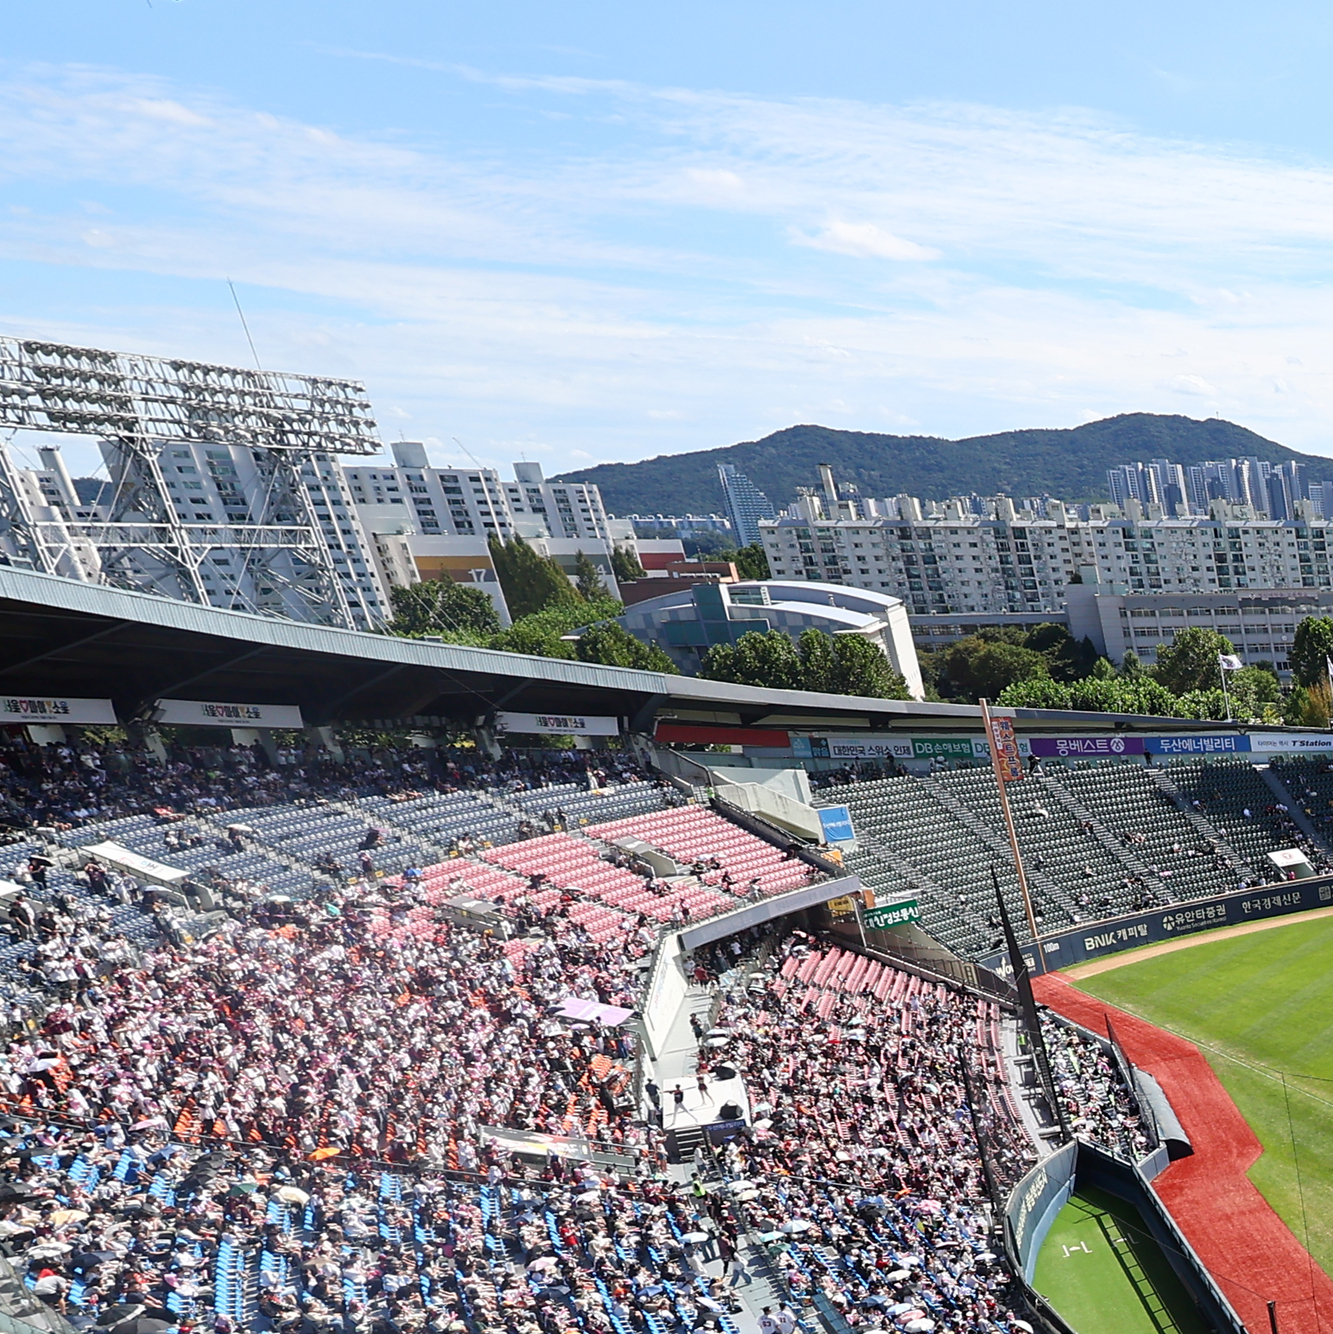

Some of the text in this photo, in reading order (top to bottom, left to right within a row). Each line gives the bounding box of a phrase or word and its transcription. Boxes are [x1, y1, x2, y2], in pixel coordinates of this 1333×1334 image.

[833, 745, 865, 756] 대한민국
[1056, 738, 1110, 756] 몽베스트
[1160, 737, 1236, 752] 두산에너빌리티
[1241, 892, 1301, 914] 한국경제신문
[1174, 904, 1227, 925] 유안타증권
[1043, 942, 1060, 953] 100m
